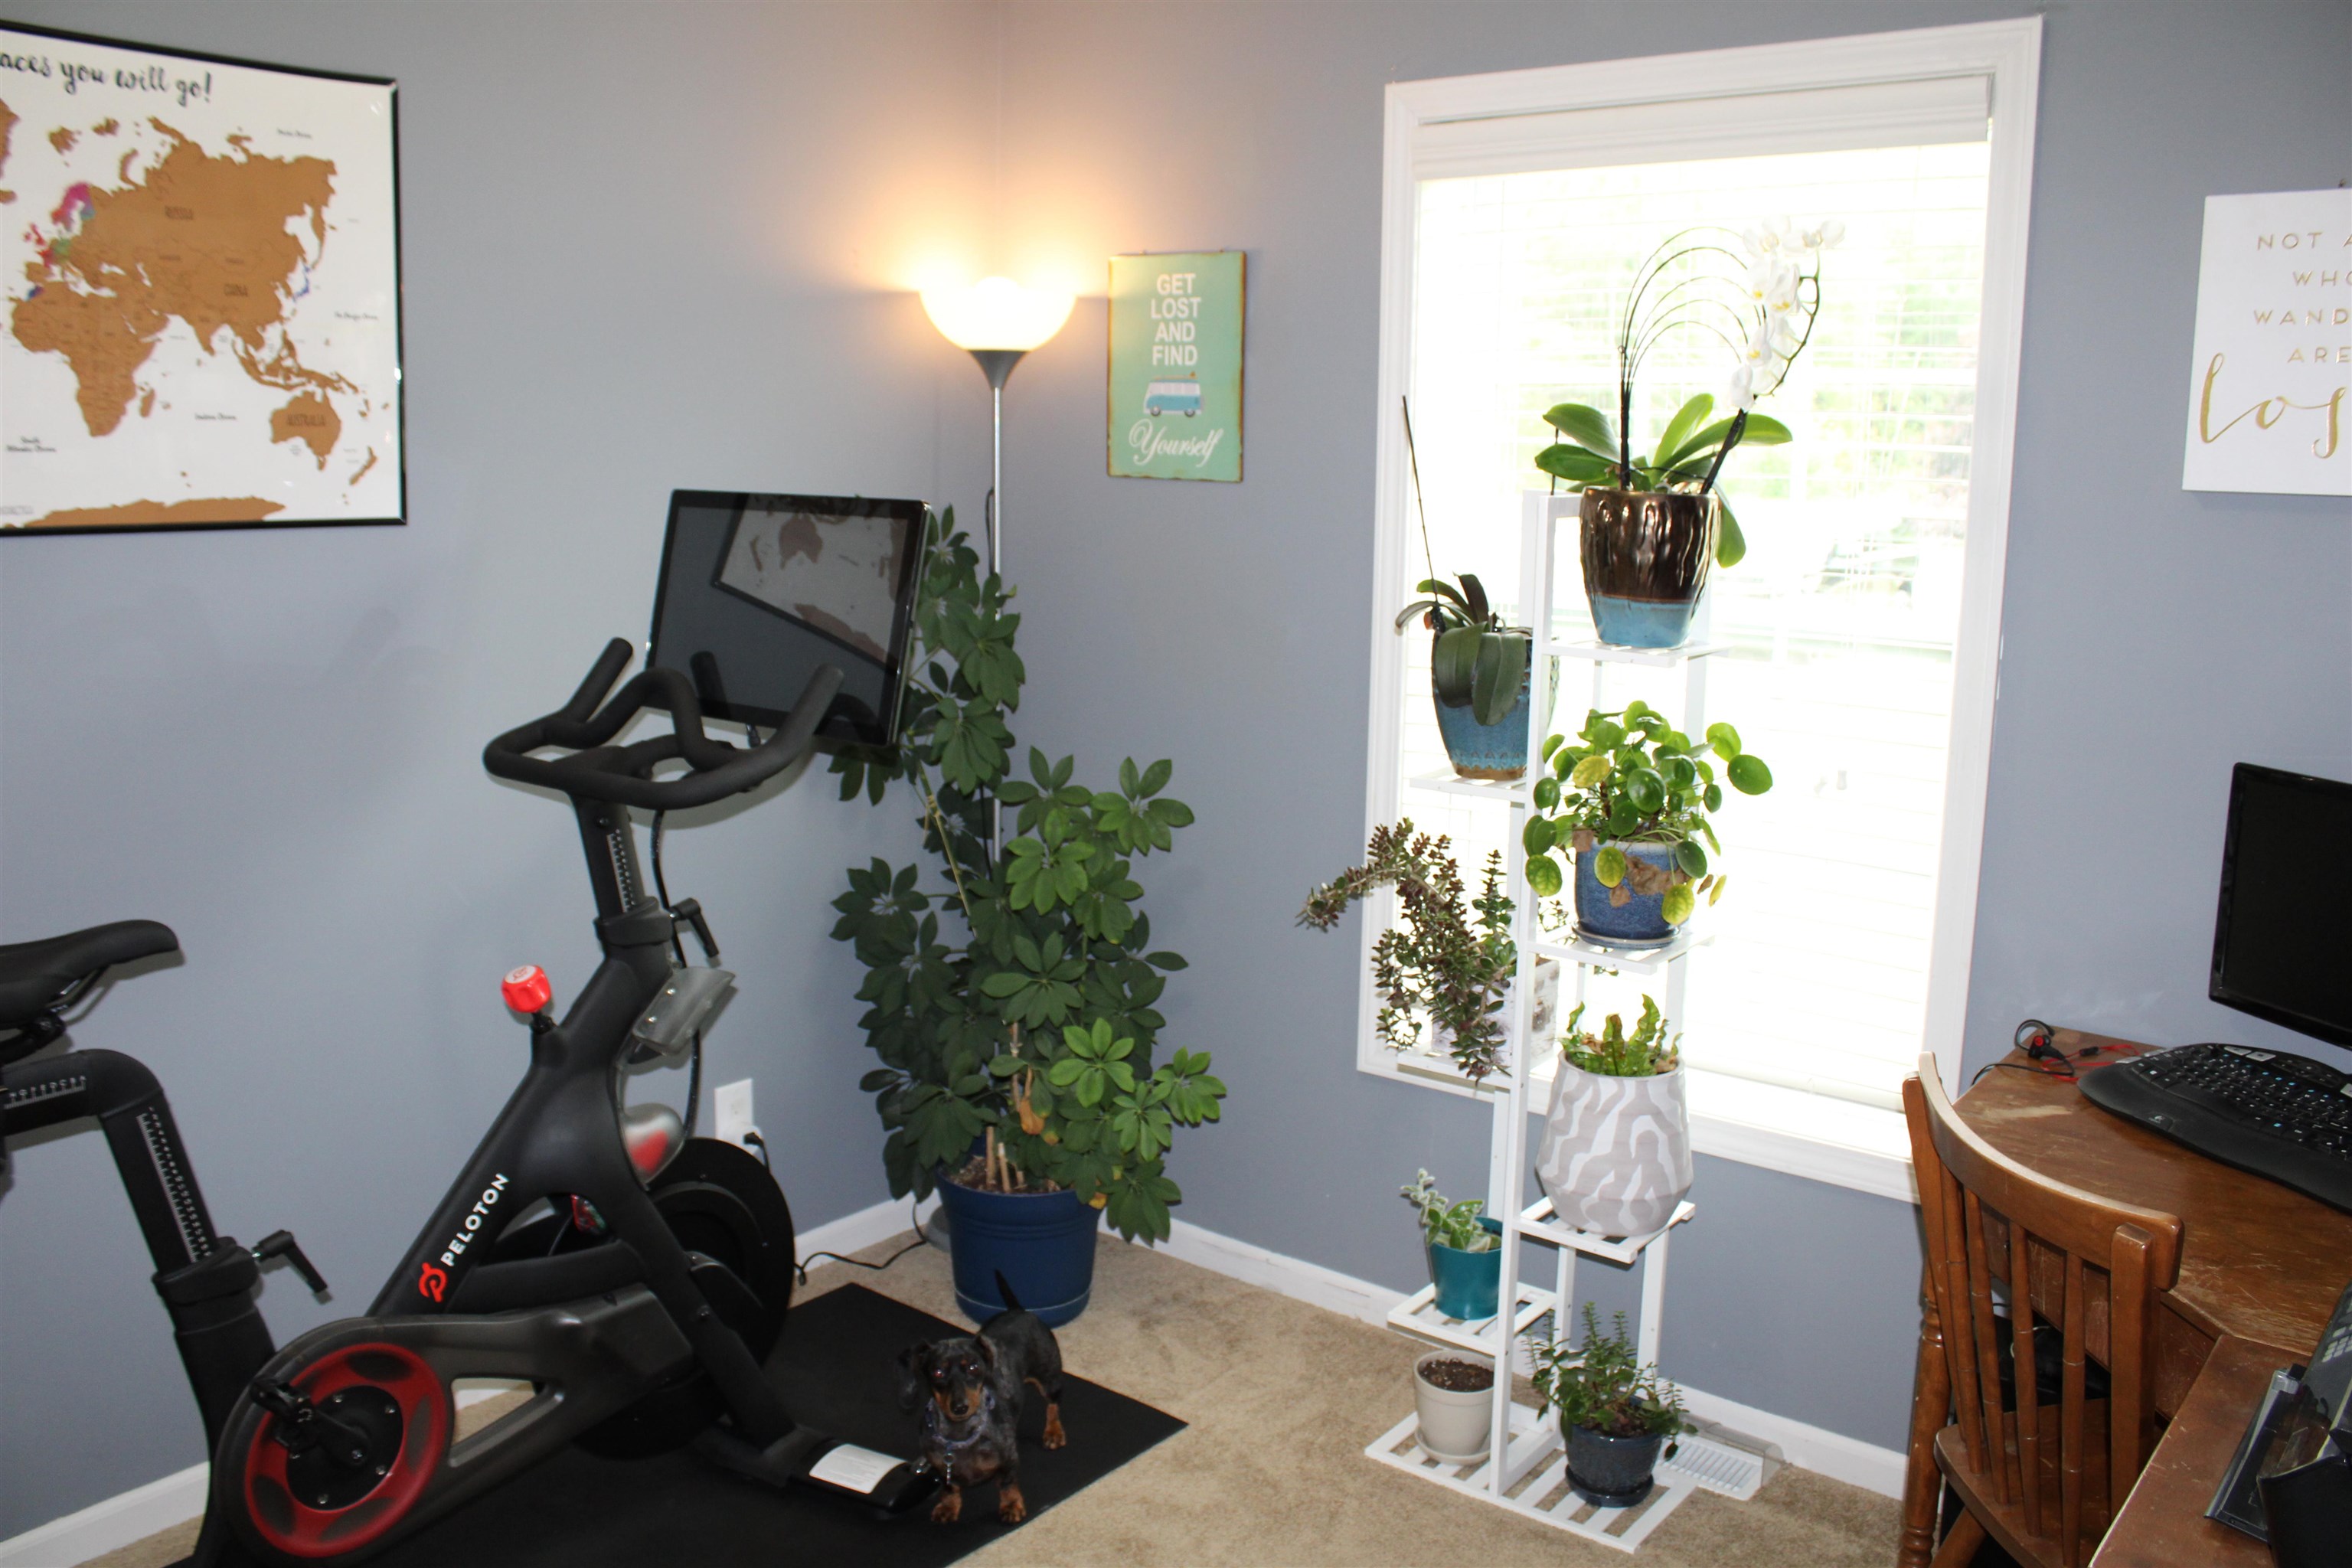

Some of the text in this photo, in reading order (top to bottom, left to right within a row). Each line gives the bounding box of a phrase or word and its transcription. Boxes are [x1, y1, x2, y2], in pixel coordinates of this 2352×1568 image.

[60, 60, 104, 95] you
[115, 65, 167, 92] will
[175, 70, 211, 108] go!
[2256, 232, 2323, 251] NOT
[1156, 273, 1196, 296] GET
[1151, 297, 1201, 319] LOST
[1155, 321, 1196, 342] AND
[1152, 345, 1198, 366] FIND
[2287, 346, 2352, 364] ARE
[1129, 419, 1224, 467] Yourself
[440, 1173, 509, 1267] PELOTON
